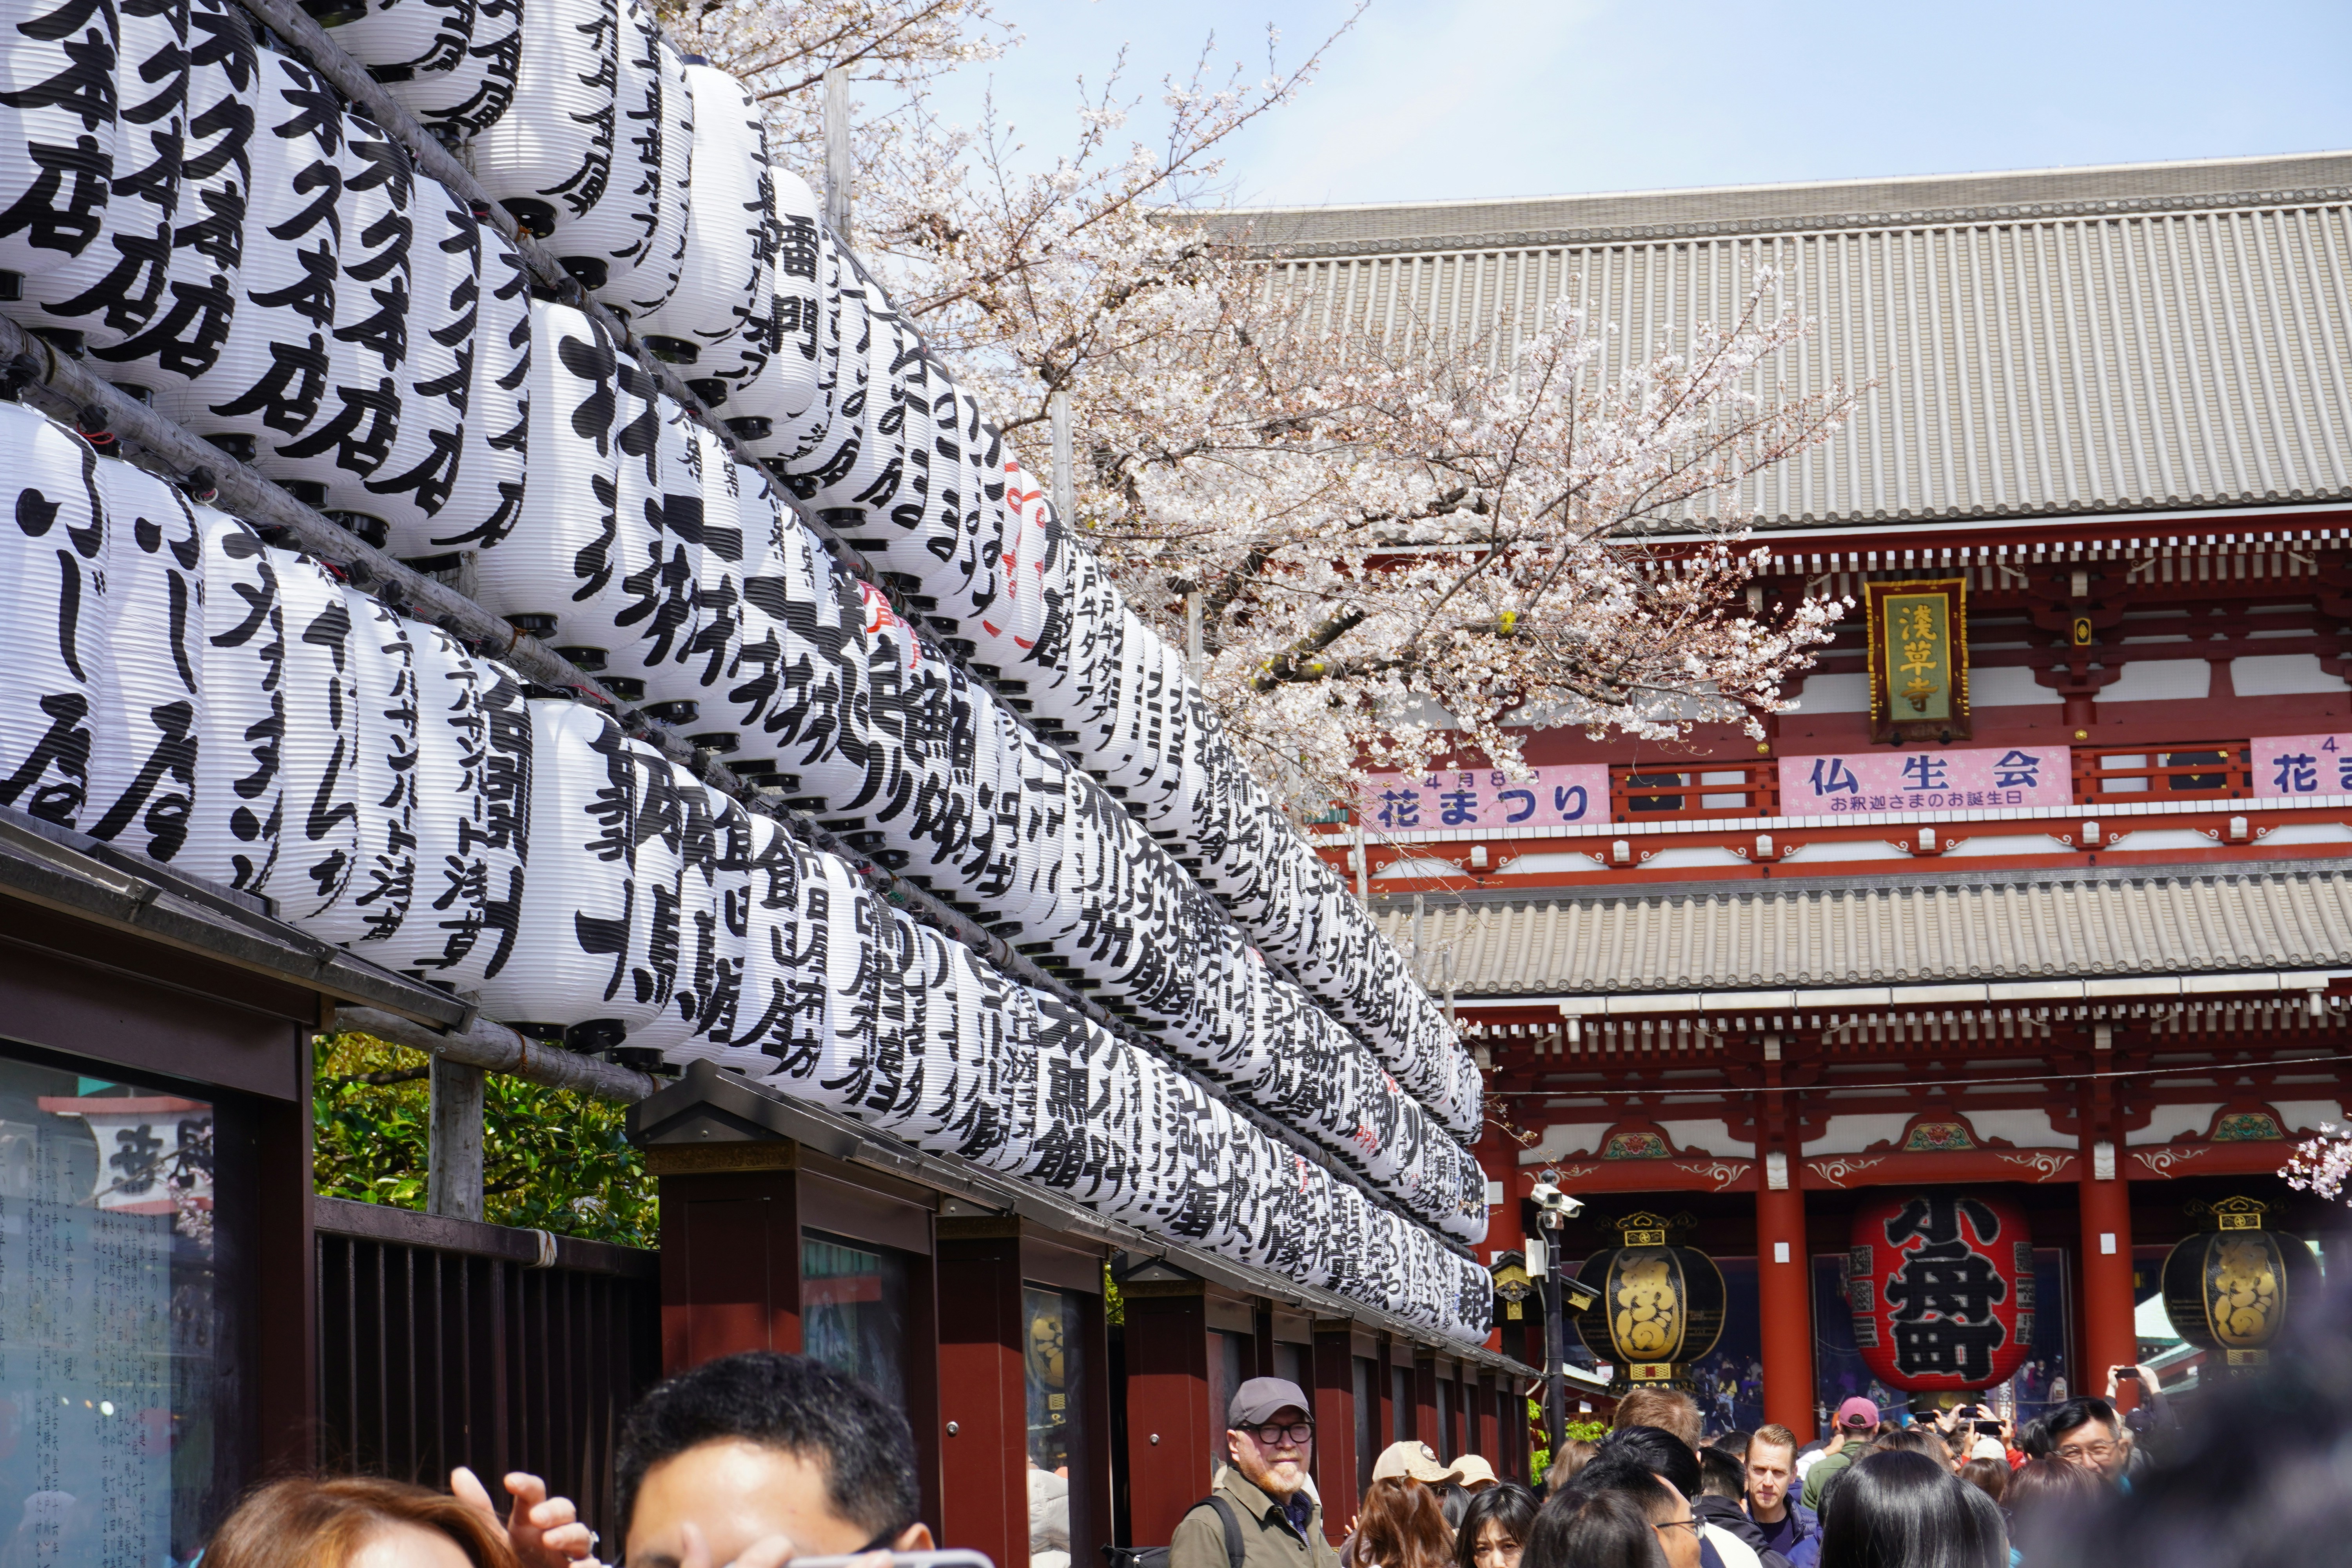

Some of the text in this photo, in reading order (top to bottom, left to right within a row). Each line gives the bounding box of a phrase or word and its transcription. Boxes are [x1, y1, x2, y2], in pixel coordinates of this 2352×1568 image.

[771, 214, 819, 361] 雷門
[1809, 750, 2042, 796] 仏生会
[1377, 785, 1588, 828] 花まつり
[1831, 790, 2022, 811] お釈迦さまのお誕生日
[1884, 1198, 2008, 1383] 小舟町
